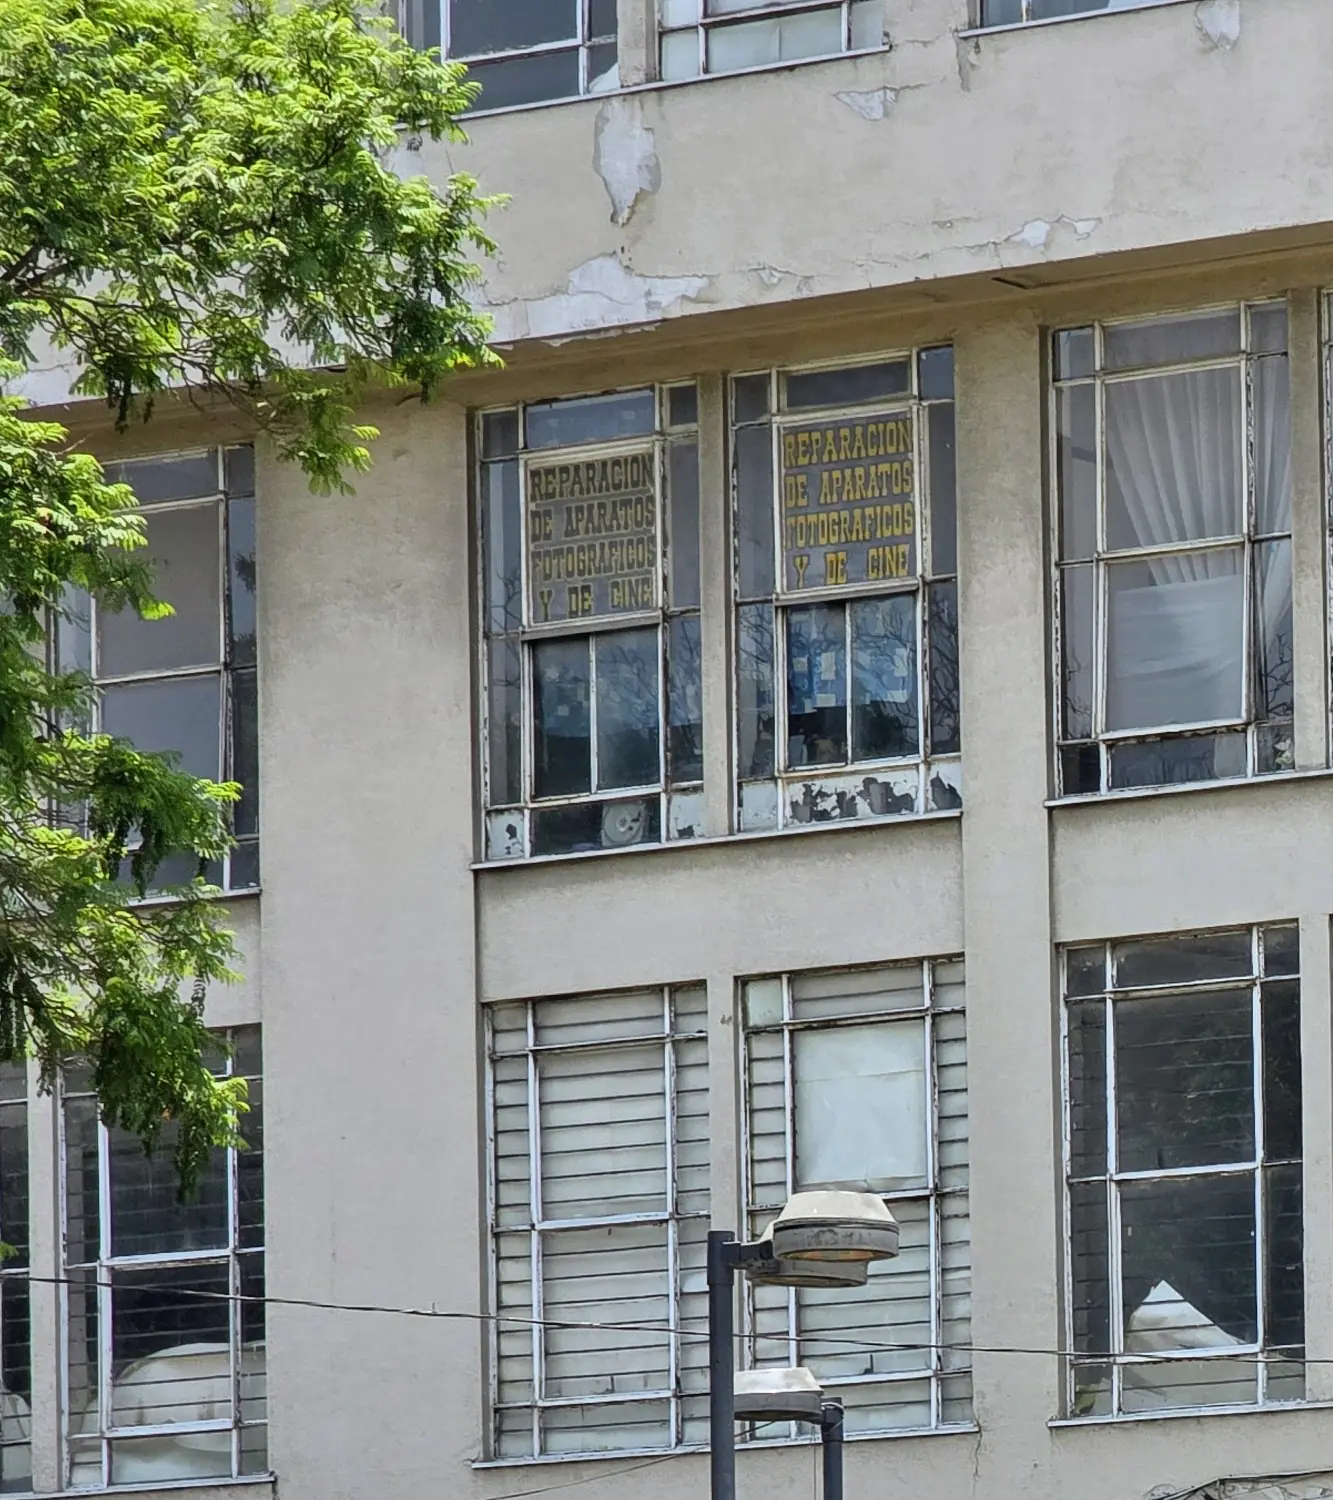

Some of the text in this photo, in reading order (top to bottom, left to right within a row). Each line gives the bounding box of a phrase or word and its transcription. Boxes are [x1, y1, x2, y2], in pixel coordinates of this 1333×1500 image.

[785, 420, 912, 468] REPARACION
[530, 455, 656, 502] REPARACION
[785, 460, 913, 508] DE APARATOS
[530, 494, 656, 543] DE APARATOS
[786, 502, 914, 550] FOTOGRAFICOS
[793, 543, 910, 589] Y DE CINE
[539, 576, 653, 622] Y DE CINE
